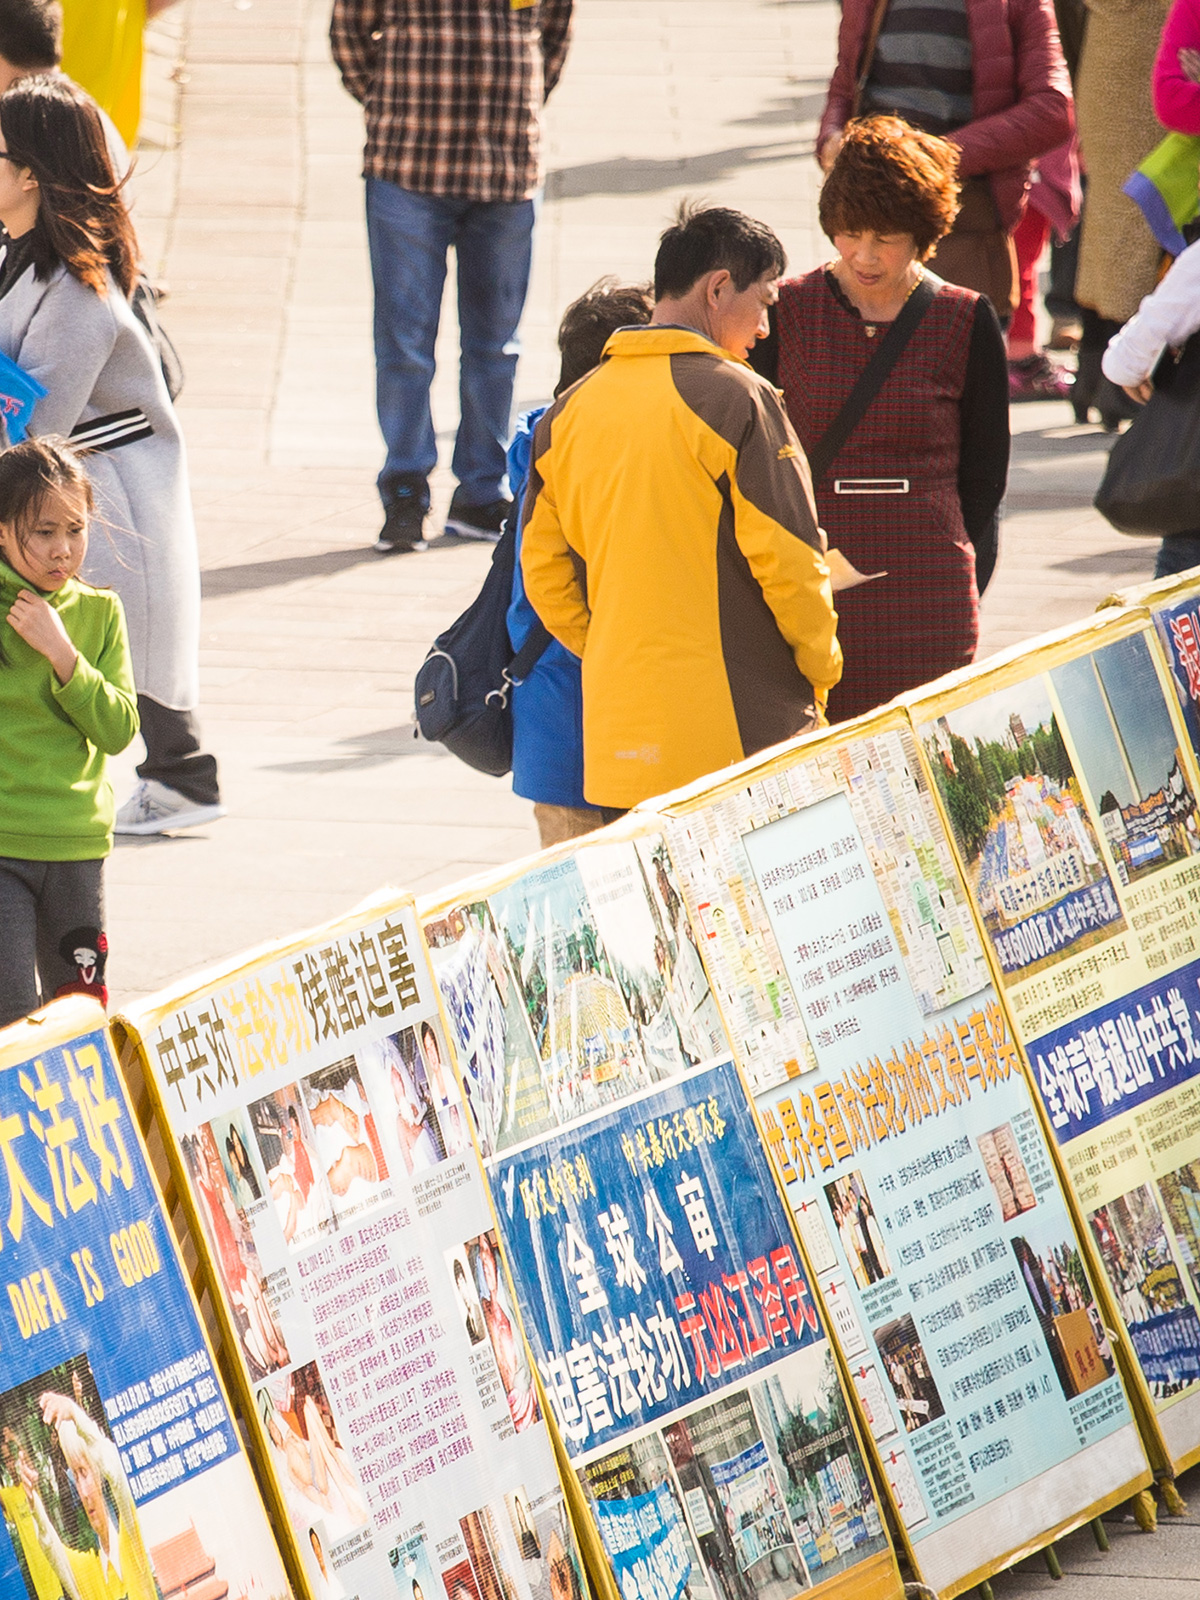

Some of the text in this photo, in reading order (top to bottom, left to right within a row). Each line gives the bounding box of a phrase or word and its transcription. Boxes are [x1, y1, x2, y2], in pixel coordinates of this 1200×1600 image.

[155, 919, 422, 1112] 中共对法轮功残酷迫害
[518, 1152, 597, 1221] 历史的审判
[620, 1094, 728, 1179] 中共暴行天理不容
[7, 1272, 67, 1340] DAFA
[72, 1246, 105, 1307] IS
[111, 1219, 161, 1290] GOOD
[564, 1171, 719, 1316] 全球公审
[538, 1243, 820, 1444] 迫害法轮功元凶江泽民
